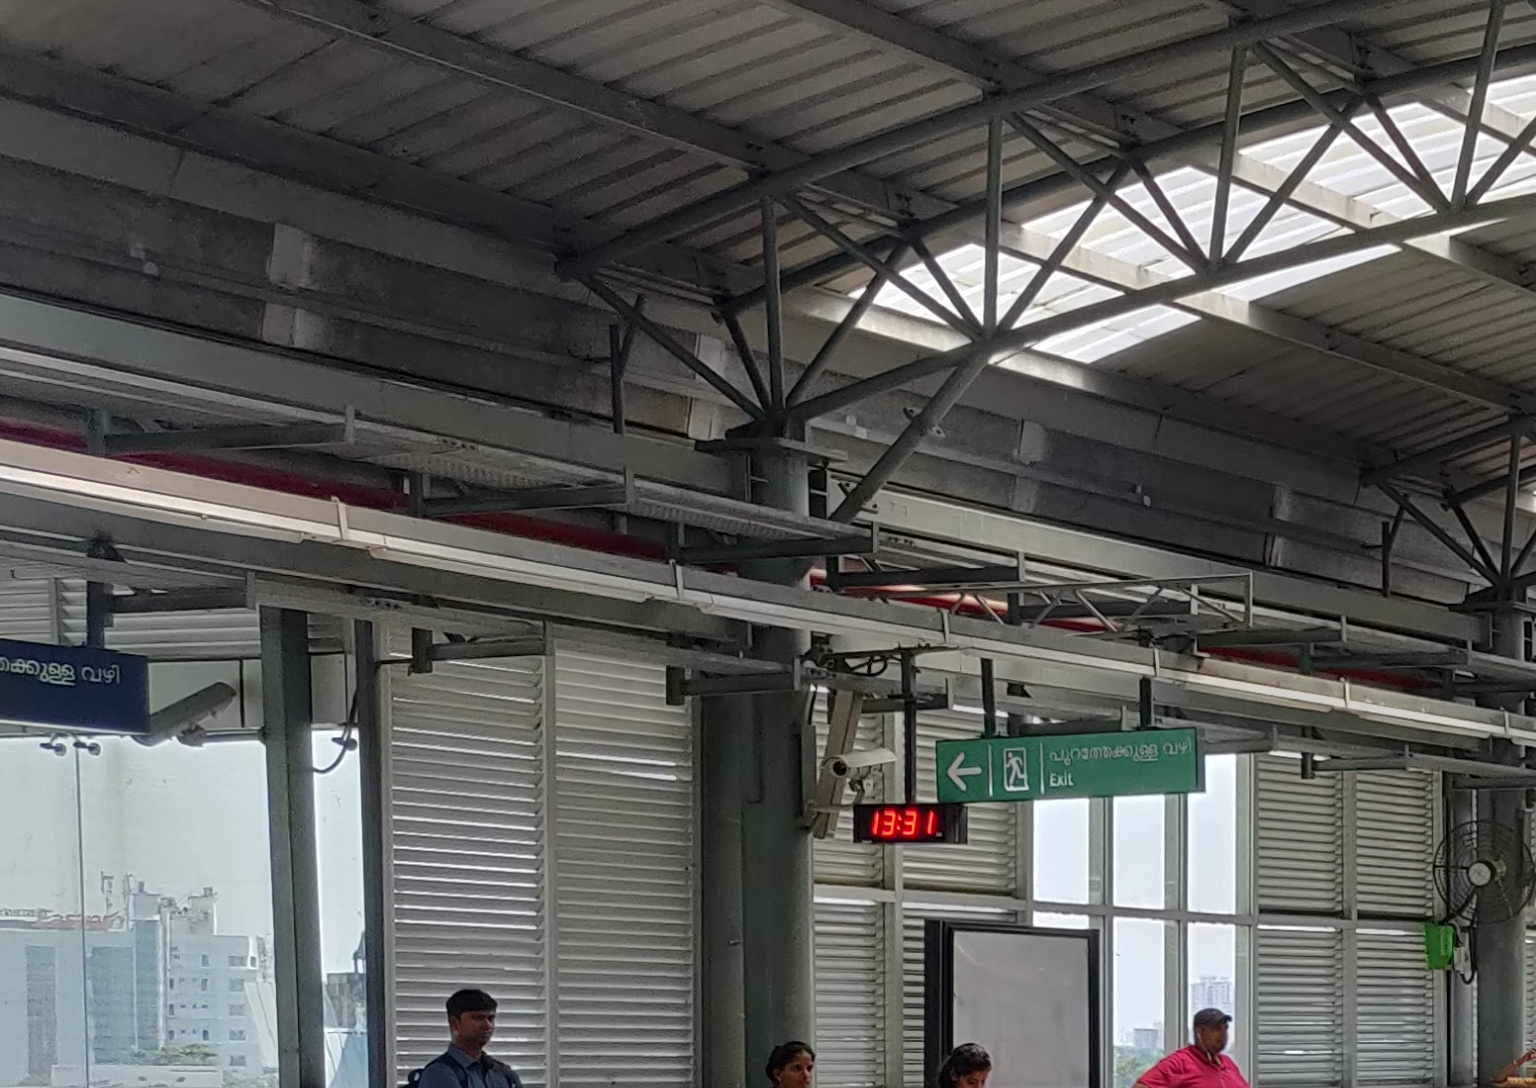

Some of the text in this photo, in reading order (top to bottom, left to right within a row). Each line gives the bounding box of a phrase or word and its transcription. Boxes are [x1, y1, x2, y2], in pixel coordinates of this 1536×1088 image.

[81, 664, 120, 685] വഴി
[1163, 737, 1192, 755] വഴി
[1050, 770, 1074, 787] Exit
[871, 809, 936, 836] 13:31
